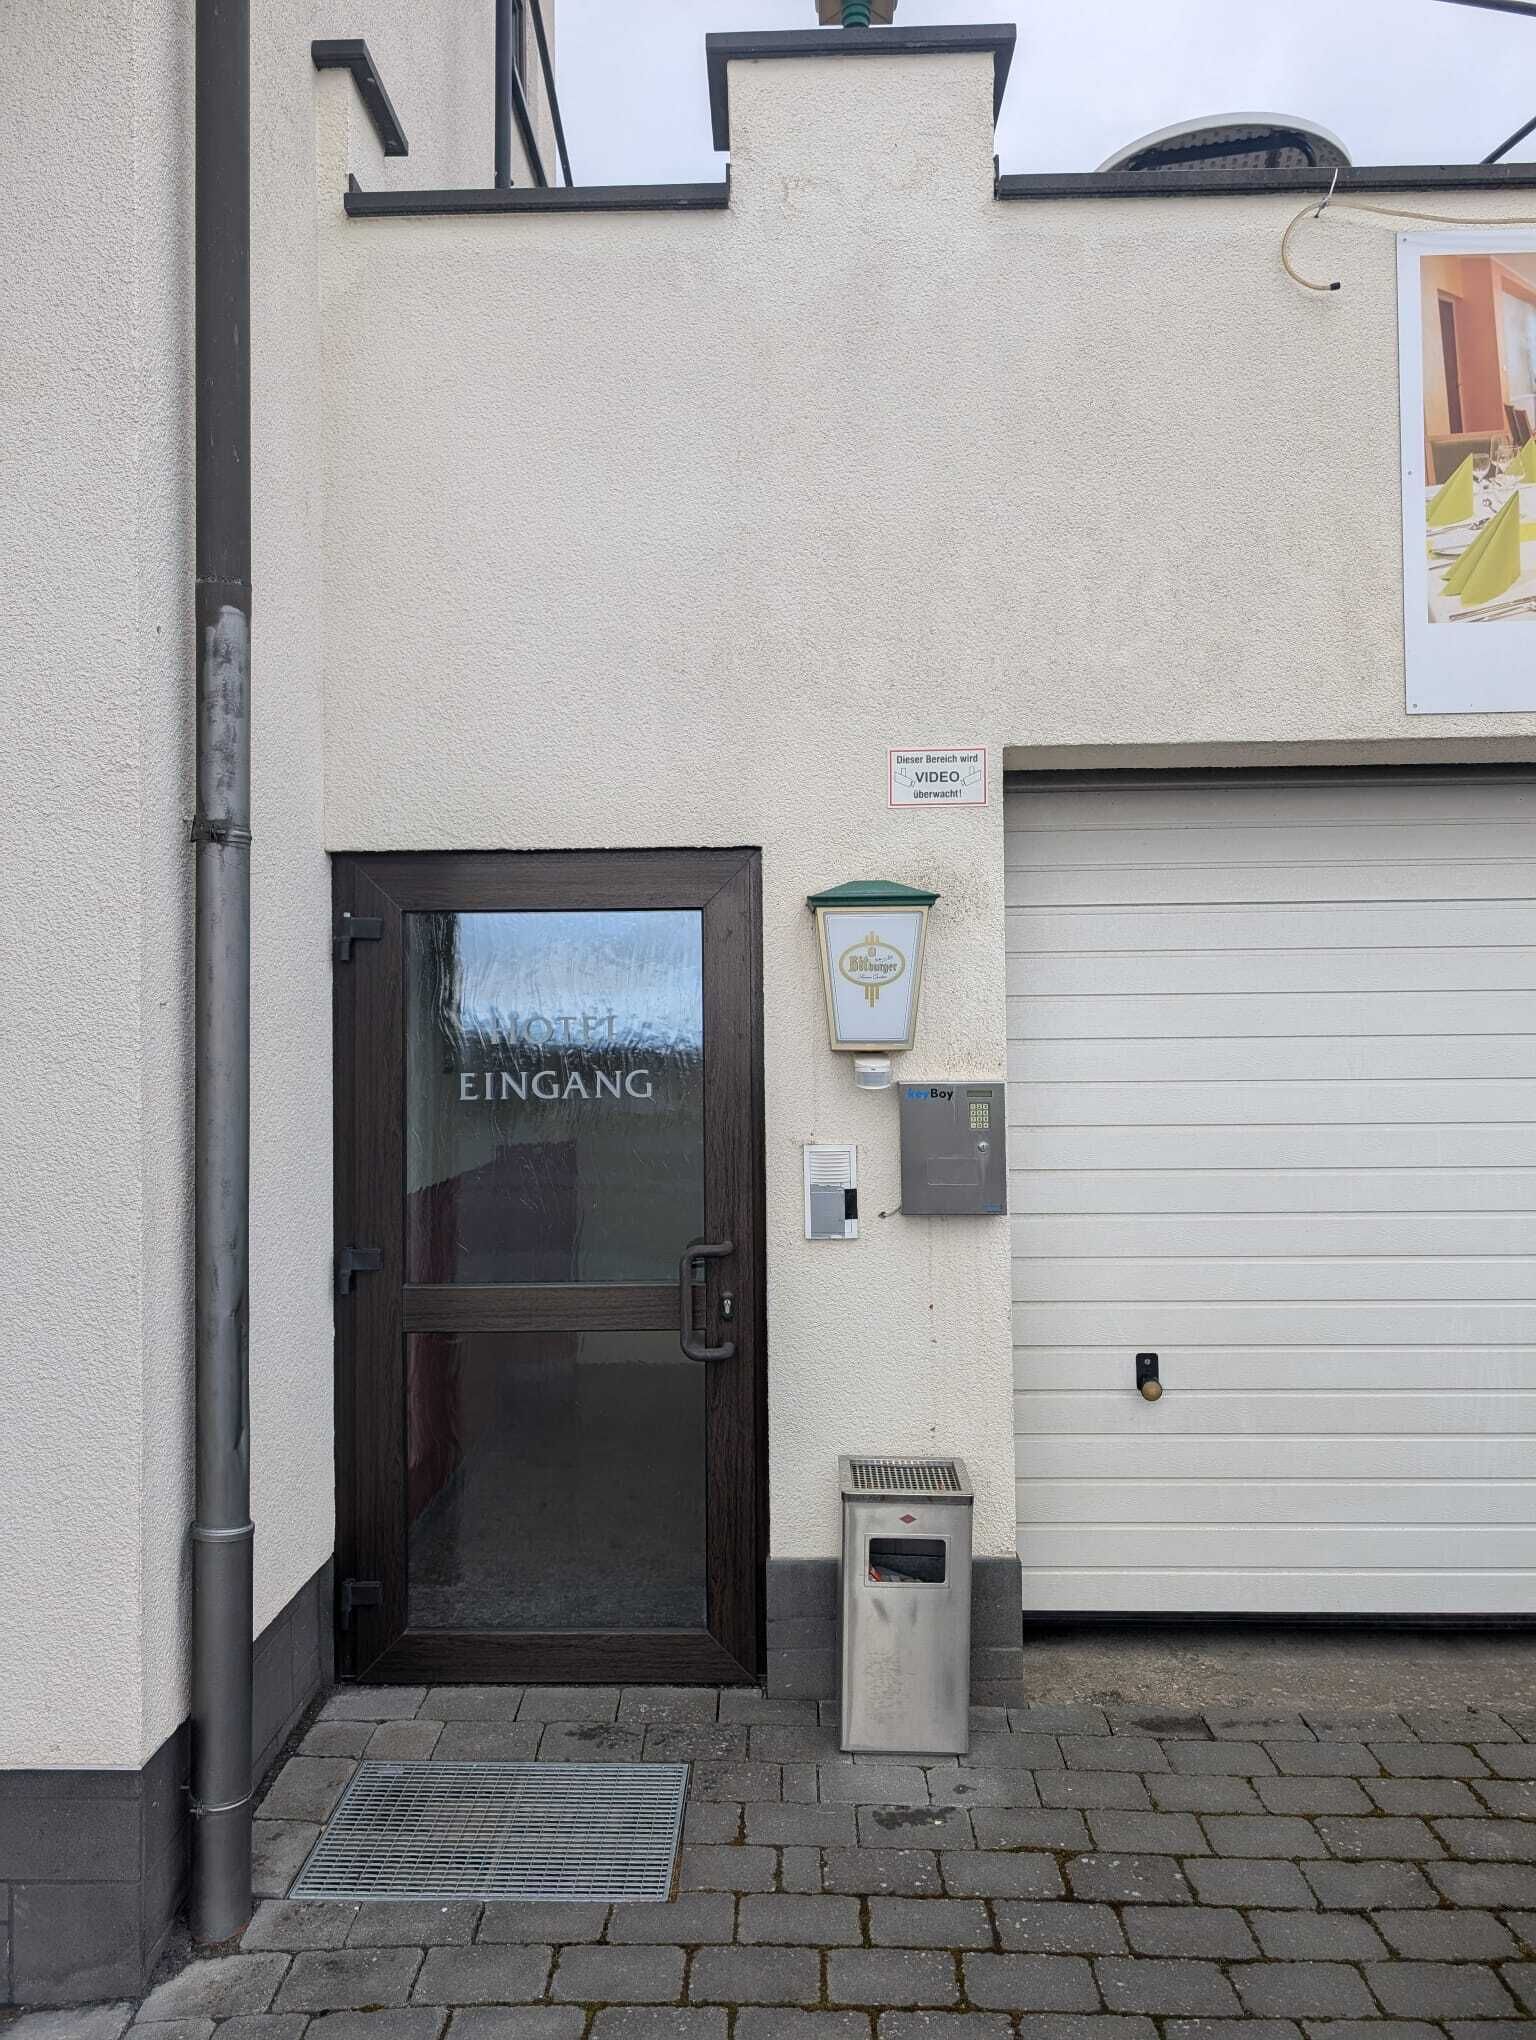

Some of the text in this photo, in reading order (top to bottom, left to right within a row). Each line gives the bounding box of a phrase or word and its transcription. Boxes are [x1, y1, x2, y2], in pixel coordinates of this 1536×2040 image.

[896, 754, 978, 764] Dieser Bereich wird
[915, 771, 960, 783] VIDEO
[913, 789, 962, 799] überwacht!
[459, 1069, 652, 1101] EINGANG
